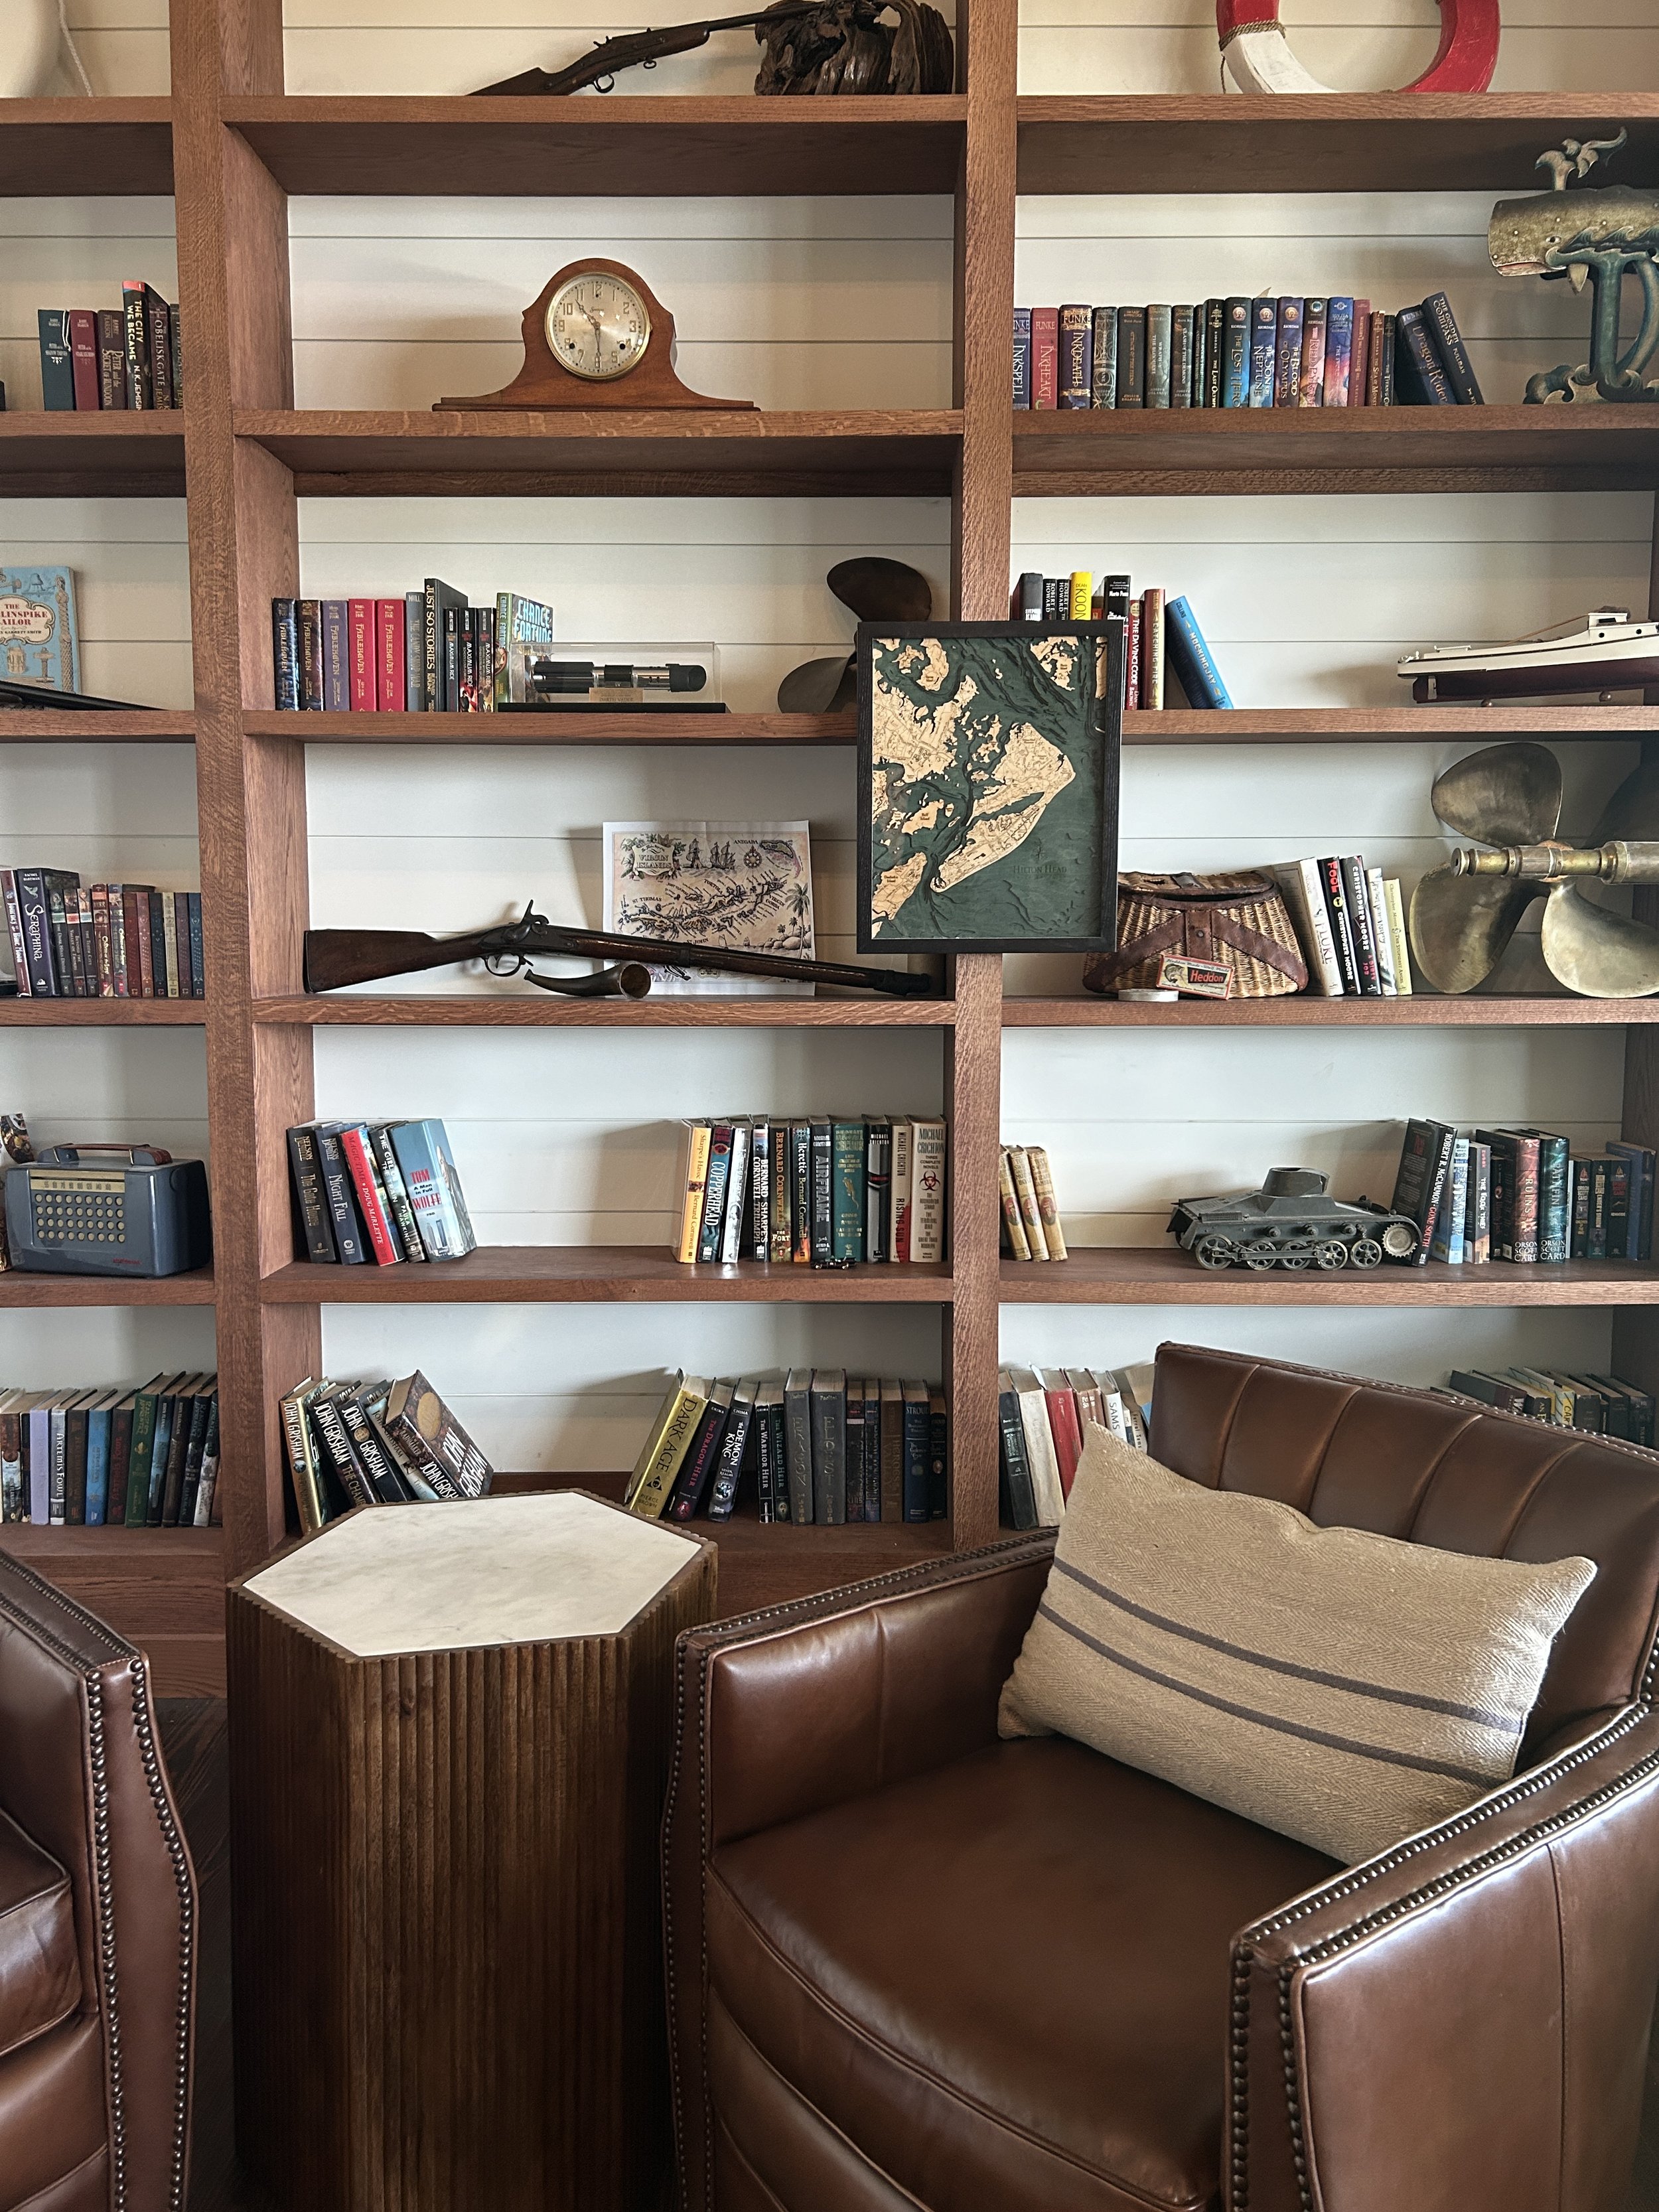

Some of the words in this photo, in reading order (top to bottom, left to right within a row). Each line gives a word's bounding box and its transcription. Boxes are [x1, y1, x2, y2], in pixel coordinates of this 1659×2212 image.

[593, 284, 602, 296] 12
[127, 305, 134, 320] WE
[623, 302, 630, 314] 2
[1063, 315, 1092, 324] FUNKE
[1439, 297, 1449, 312] THE
[1445, 313, 1460, 344] GOLDEN
[559, 320, 565, 332] 9
[629, 320, 636, 332] 3
[1035, 321, 1056, 330] FUNKE
[1433, 300, 1453, 346] COMPASS
[128, 323, 137, 360] BECAME
[154, 320, 163, 360] OBELISK
[577, 348, 585, 363] 7
[1070, 332, 1084, 387] INKDEATH
[1231, 348, 1243, 375] LOST
[1412, 326, 1436, 370] Dragon
[1428, 369, 1448, 402] Rider
[1453, 347, 1465, 374] PULLMAN
[157, 362, 166, 386] GATE
[1013, 344, 1027, 399] INKSPELL
[1039, 345, 1055, 400] INKHEART
[1254, 346, 1265, 396] NEPTUNE
[1290, 358, 1300, 396] BLOOD
[1230, 376, 1243, 407] HERO
[427, 614, 435, 626] SO
[517, 599, 550, 629] CHANCE
[514, 619, 552, 642] FORTUNE
[1175, 601, 1187, 619] COLLINS
[1189, 632, 1216, 684] MOCKINGJAY
[304, 621, 313, 671] FABLEHAVEN
[330, 625, 340, 675] FABLEHAVEN
[356, 623, 364, 674] FABLEHAVEN
[1013, 865, 1043, 875] HILTON
[1045, 865, 1068, 875] HEAD
[704, 879, 723, 895] TORTOLA
[1327, 861, 1340, 893] FOOL
[1338, 911, 1350, 956] CHRISTOPHER
[1344, 956, 1354, 980] MOORE
[1352, 866, 1365, 921] CHRISTOPHER
[1360, 922, 1370, 950] MOORE
[24, 903, 44, 961] SERAPHINA
[1190, 970, 1224, 983] Heddon
[697, 1134, 707, 1159] Sharpe's
[897, 1132, 907, 1153] MICHAEL
[918, 1143, 945, 1153] CRICHTON
[919, 1128, 944, 1140] MICHAEL
[1439, 1133, 1454, 1160] ROBERT
[305, 1136, 314, 1161] NELSON
[379, 1134, 388, 1149] THE
[384, 1151, 394, 1169] GIRL
[776, 1132, 784, 1173] BERNARD
[798, 1142, 807, 1174] Heretic
[696, 1160, 706, 1179] Havoc
[897, 1153, 906, 1176] CRICHTON
[329, 1173, 343, 1201] NIGHT
[347, 1136, 361, 1161] MAGIC
[354, 1161, 366, 1182] TIME
[362, 1187, 373, 1207] DOUG
[368, 1208, 384, 1244] MARLETTE
[704, 1161, 727, 1226] COPPERHEAD
[776, 1175, 785, 1223] CORNWELL
[816, 1155, 830, 1222] AIRFRAME
[1431, 1168, 1445, 1204] McCAMMON
[1524, 1178, 1534, 1214] RUINS
[333, 1201, 349, 1222] FALL
[400, 1205, 411, 1225] PAULA
[691, 1195, 700, 1220] Bernard
[895, 1198, 905, 1224] RISING
[1426, 1206, 1437, 1224] GONE
[397, 1213, 410, 1242] HAWKINS
[688, 1221, 699, 1250] Cornwell
[798, 1206, 807, 1238] Cornwell
[895, 1227, 905, 1243] SUN
[1421, 1226, 1433, 1248] SOUTH
[283, 1402, 299, 1424] JOHN
[667, 1397, 697, 1440] DARK
[708, 1420, 717, 1432] THE
[1109, 1402, 1120, 1430] SAMS
[56, 1433, 65, 1471] ARTEMIS
[288, 1424, 304, 1459] GRISHAM
[341, 1404, 364, 1430] JOHN
[360, 1440, 388, 1479] GRISHAM
[696, 1432, 713, 1464] DRAGON
[722, 1432, 735, 1458] KING
[776, 1430, 784, 1465] WIZARD
[655, 1441, 678, 1472] AGE
[56, 1472, 65, 1497] FOWL
[688, 1465, 702, 1487] HEIR
